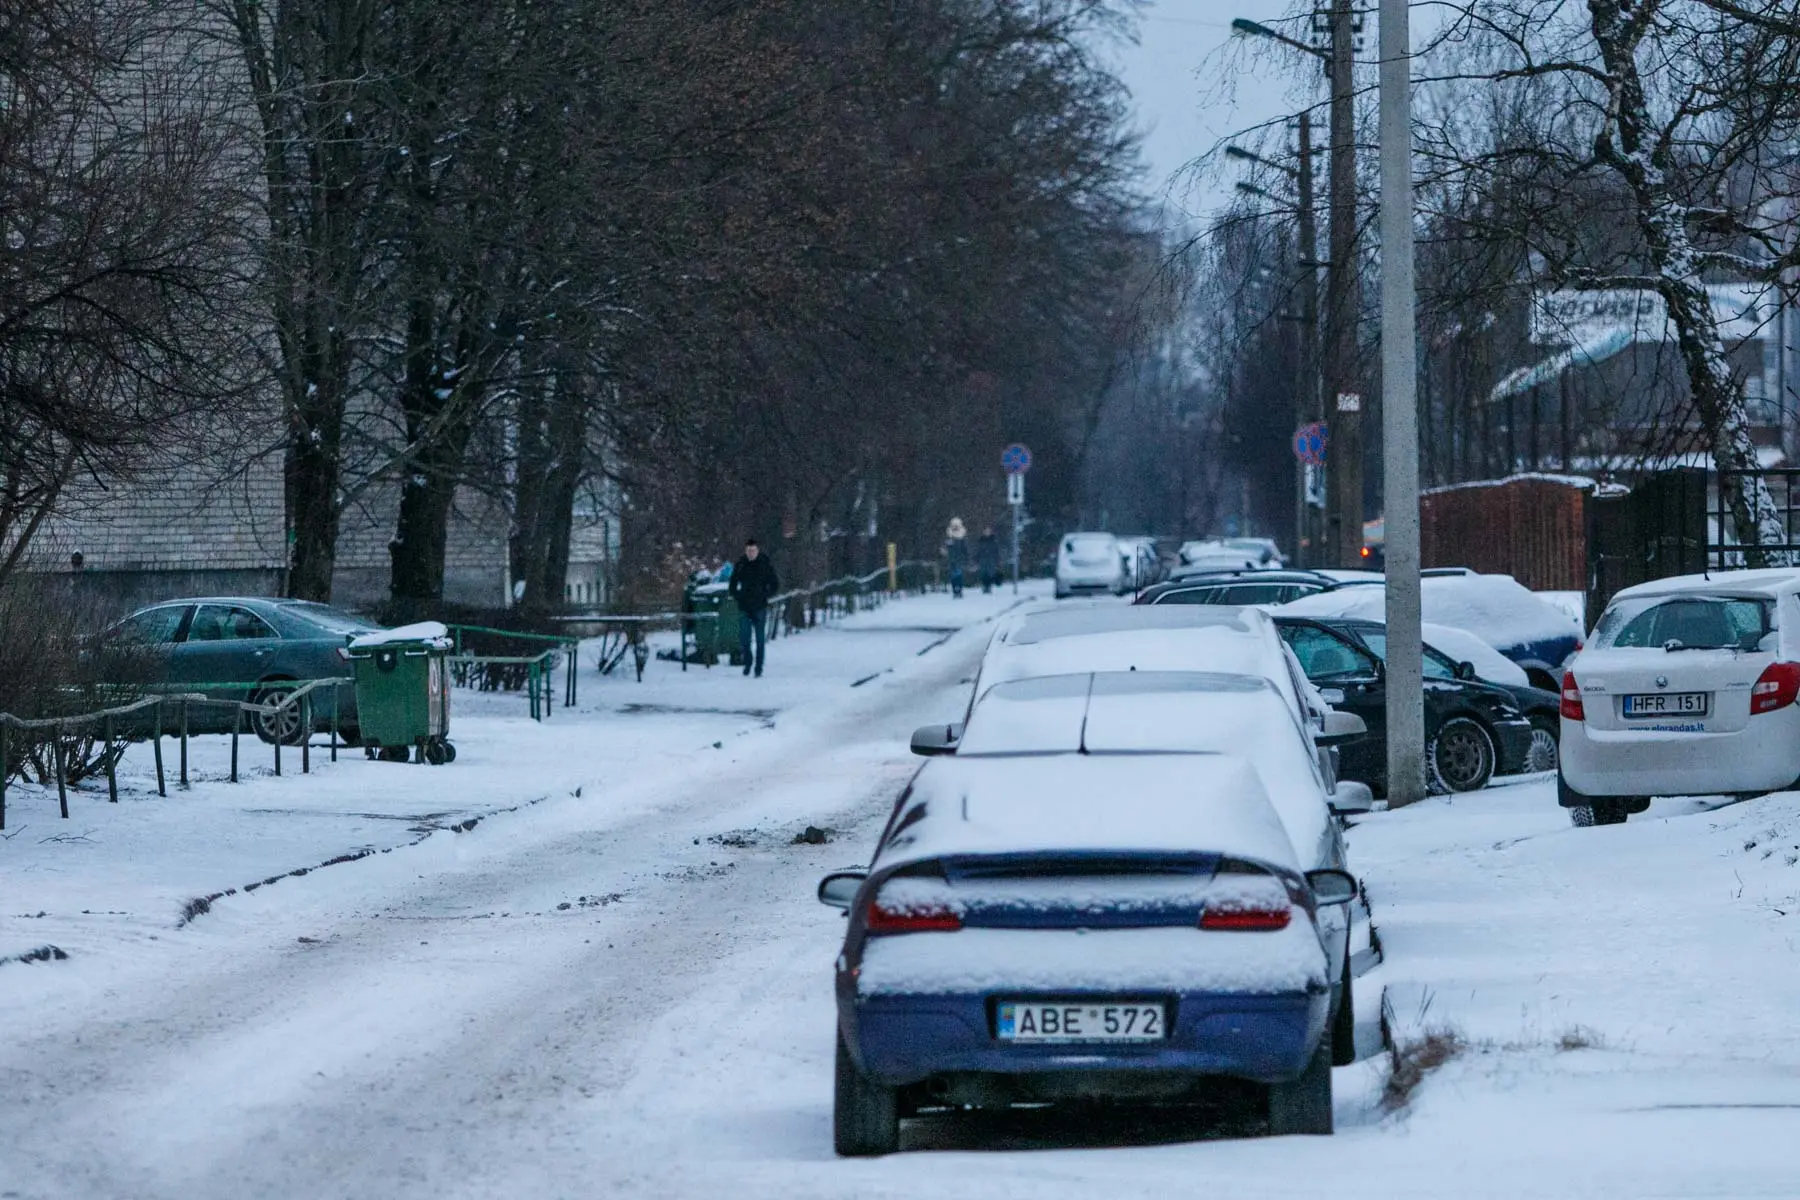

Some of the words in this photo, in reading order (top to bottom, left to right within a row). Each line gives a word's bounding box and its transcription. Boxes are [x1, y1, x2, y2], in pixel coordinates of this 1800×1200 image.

[1633, 696, 1665, 711] HFR
[1677, 695, 1702, 710] 151
[1020, 1008, 1082, 1034] ABE
[1103, 1008, 1158, 1034] 572
